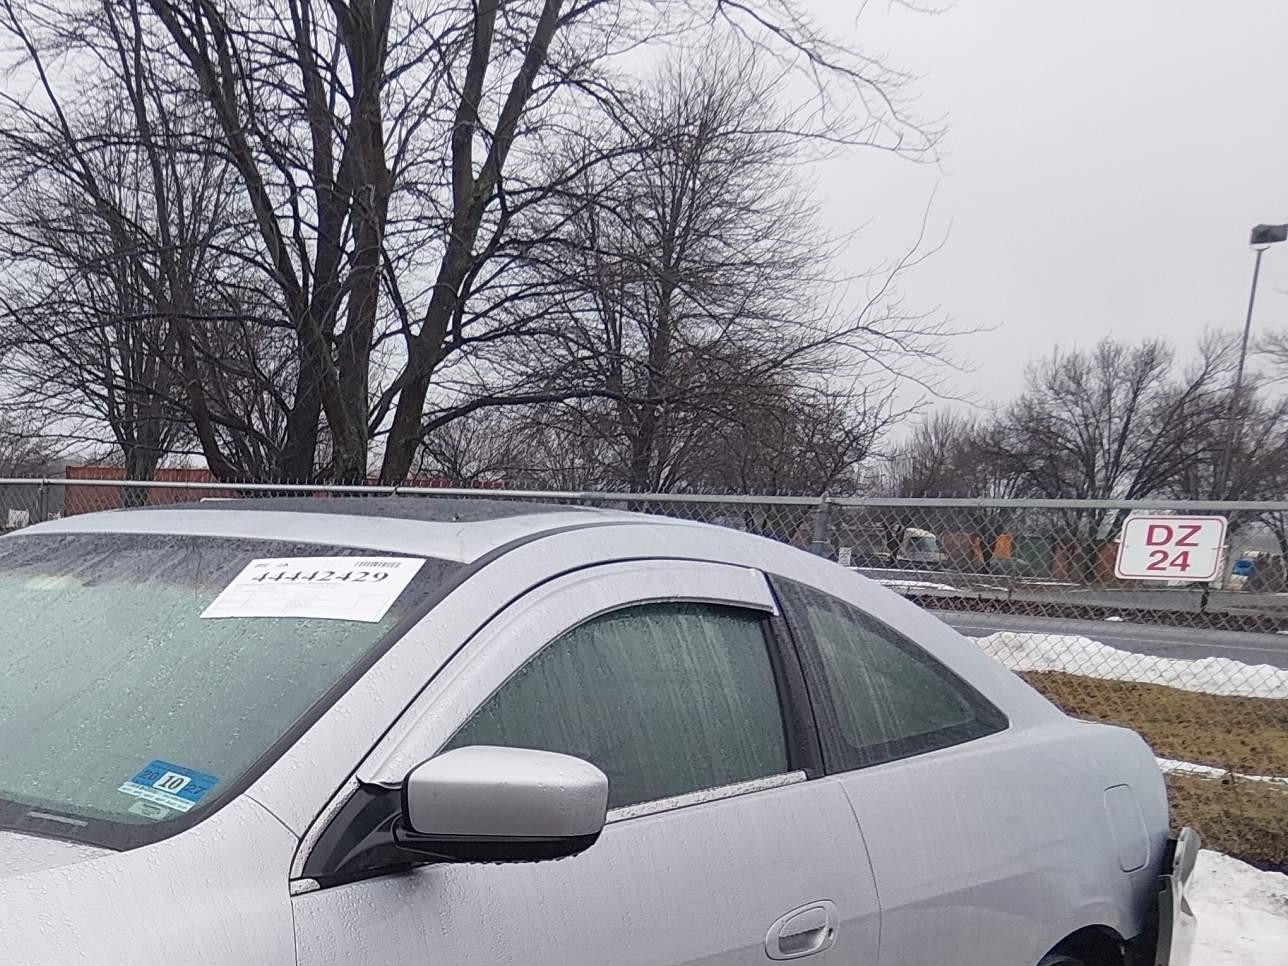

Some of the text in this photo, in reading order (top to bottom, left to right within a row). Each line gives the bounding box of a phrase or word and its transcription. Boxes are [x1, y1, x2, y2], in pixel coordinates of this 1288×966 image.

[1145, 524, 1202, 547] DZ
[1146, 549, 1191, 572] 24
[252, 570, 389, 583] 44442429
[158, 775, 185, 790] 10
